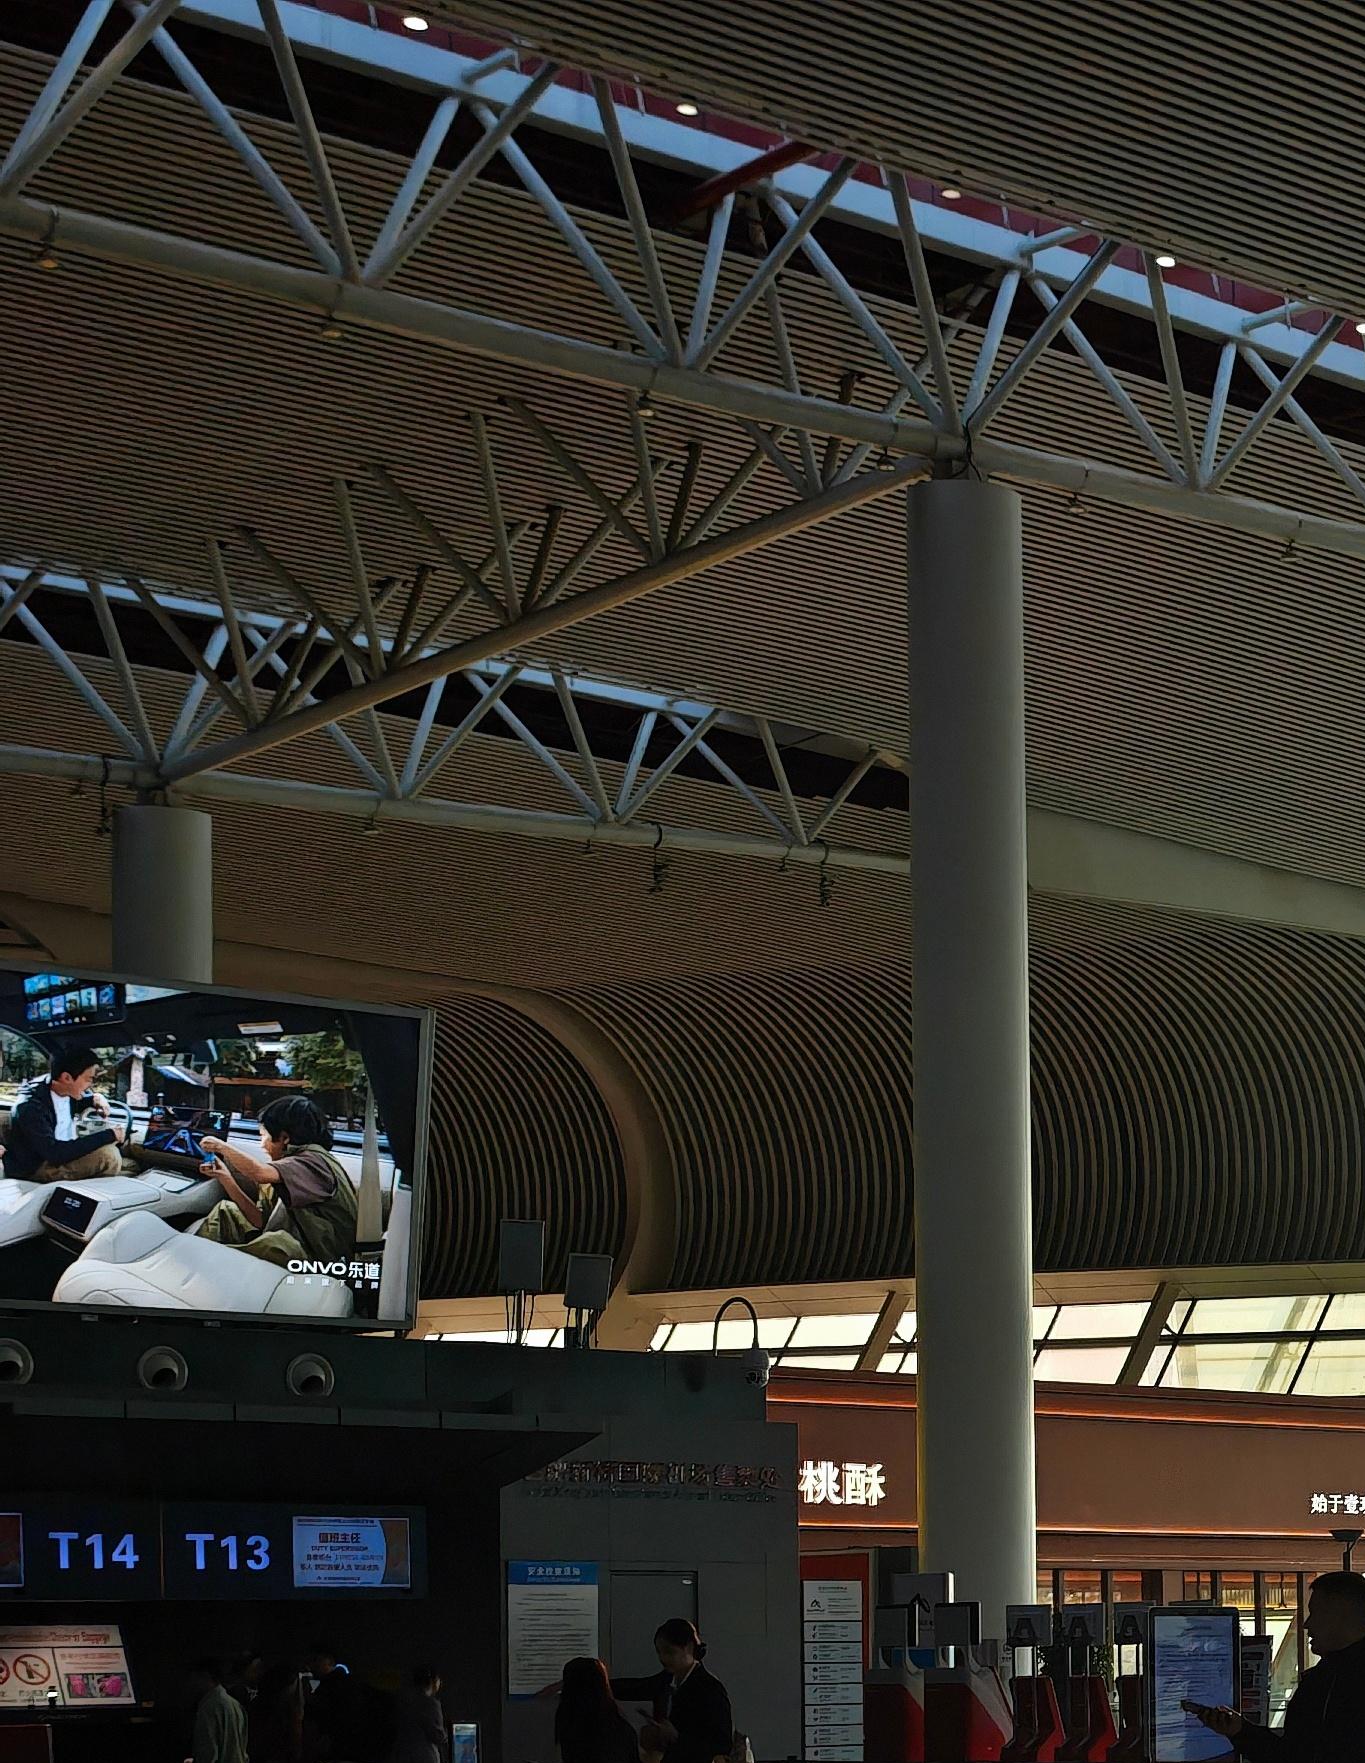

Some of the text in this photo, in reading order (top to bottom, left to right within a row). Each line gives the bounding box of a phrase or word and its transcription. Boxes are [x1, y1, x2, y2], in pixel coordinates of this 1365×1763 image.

[287, 1259, 380, 1279] ONVO 乐道
[798, 1460, 886, 1506] 桃酥
[49, 1532, 139, 1569] T14
[185, 1533, 270, 1570] T13
